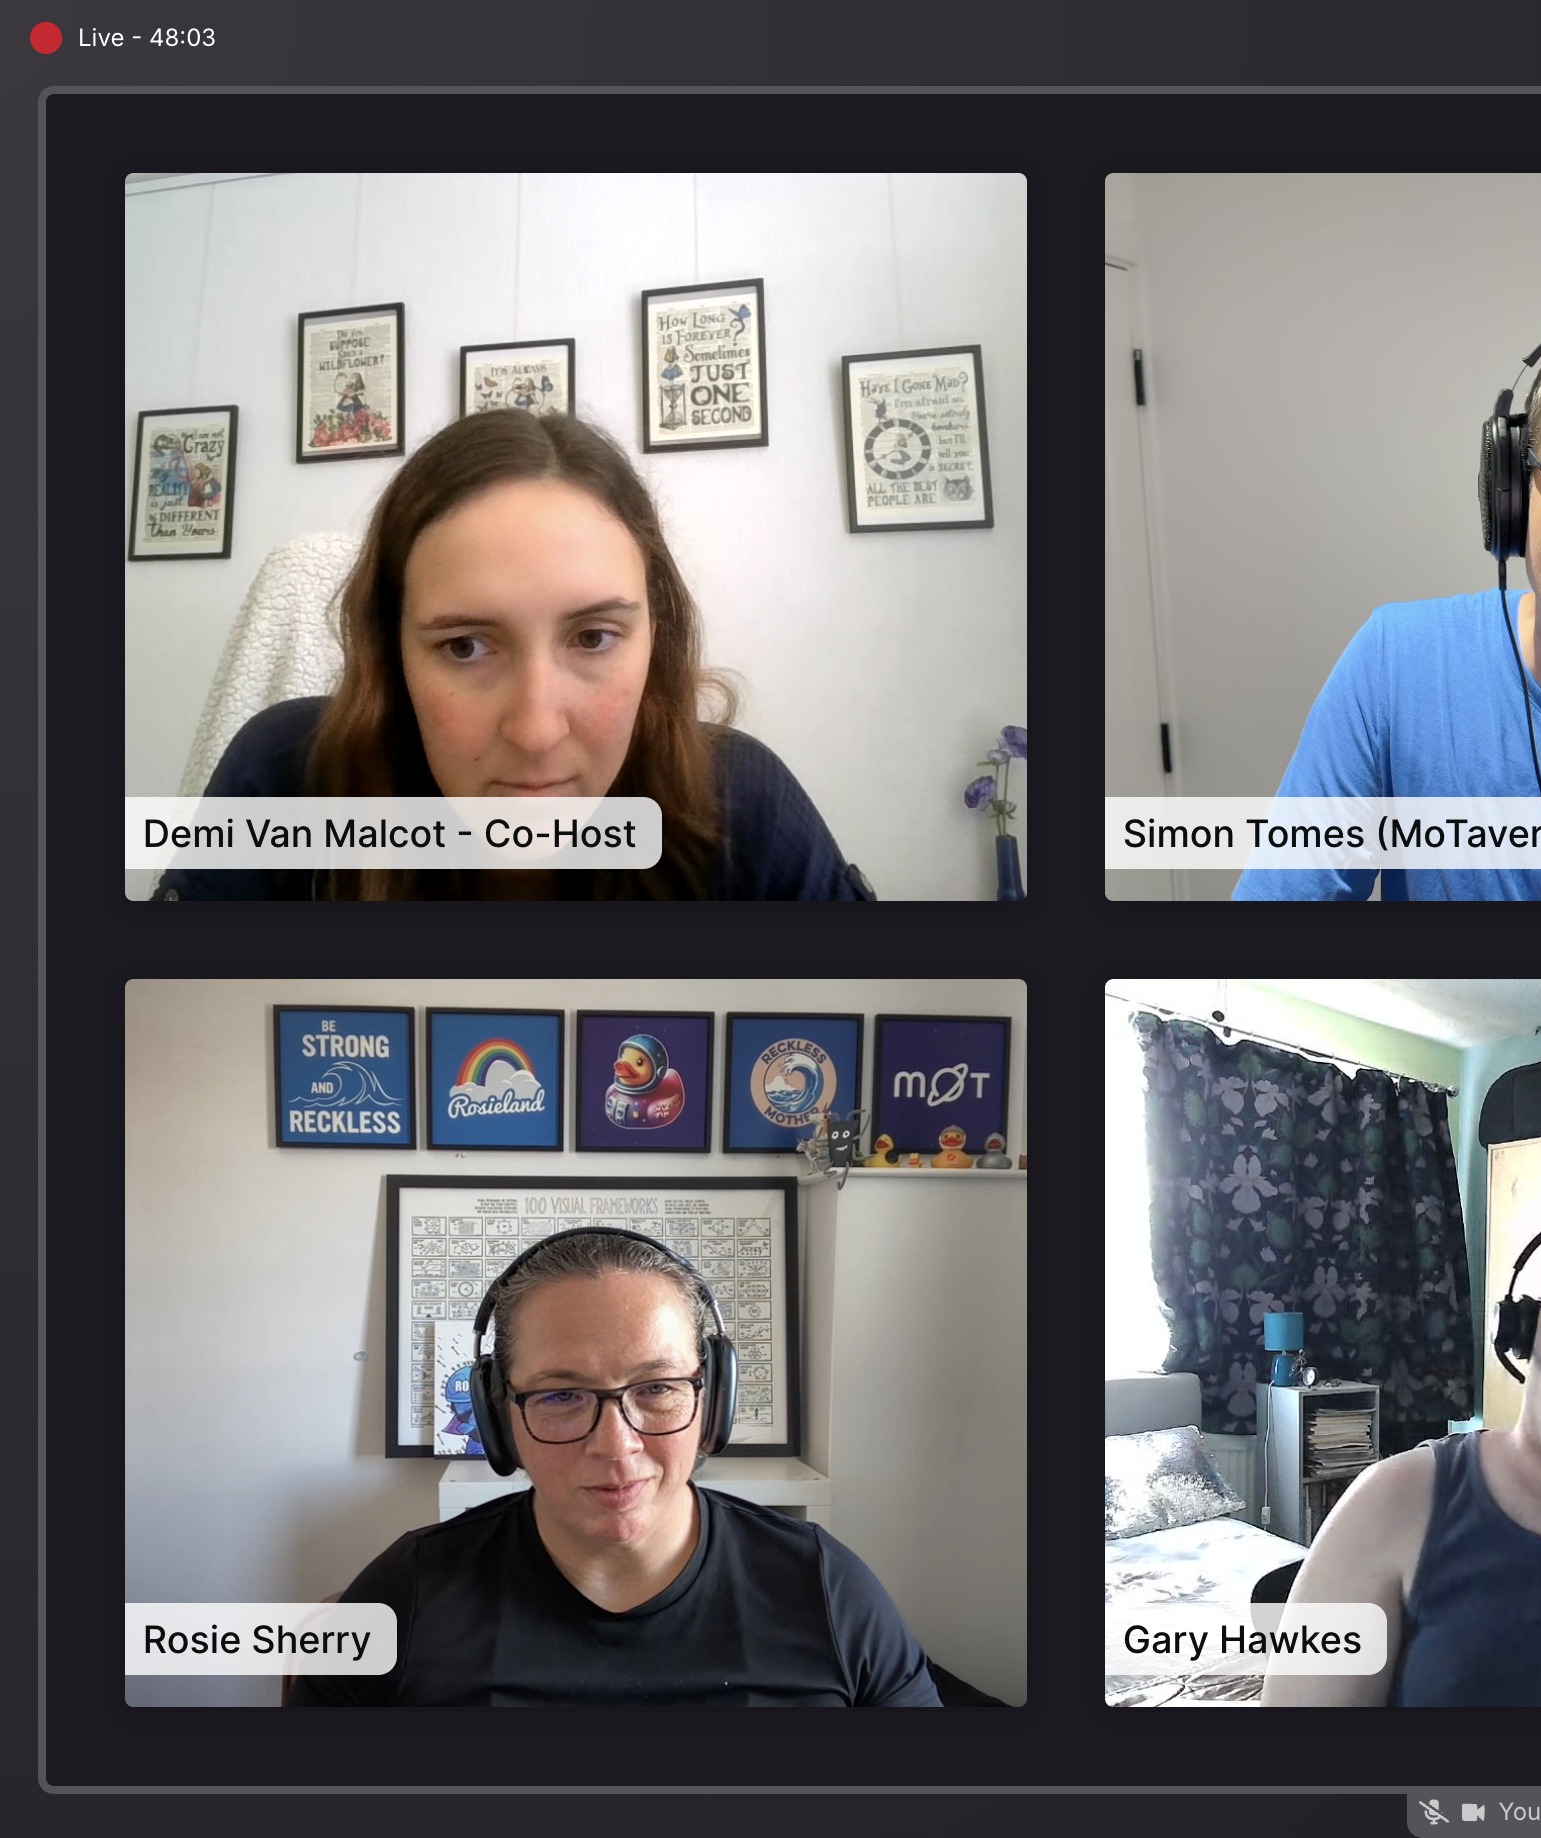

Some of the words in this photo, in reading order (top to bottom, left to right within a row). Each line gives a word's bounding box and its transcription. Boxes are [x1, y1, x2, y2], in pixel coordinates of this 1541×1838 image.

[683, 344, 751, 363] Sometimes
[690, 359, 751, 383] JUST
[690, 382, 750, 406] ONE
[691, 405, 752, 425] SECOND
[183, 435, 225, 457] Crazy
[867, 481, 886, 495] ALL
[890, 481, 910, 493] THE
[913, 479, 938, 492] BEST
[867, 494, 910, 508] PEOPLE
[914, 493, 936, 506] ARE
[159, 509, 220, 522] DIFFERENT
[321, 1020, 336, 1032] BE
[302, 1034, 390, 1058] STRONG
[761, 1040, 827, 1065] RECKLESS
[311, 1081, 334, 1094] AND
[448, 1089, 545, 1118] Rosieland
[289, 1110, 401, 1135] RECKLESS
[524, 1196, 547, 1214] 100
[550, 1196, 587, 1214] VISUAL
[589, 1196, 659, 1215] FRAMEWORKS
